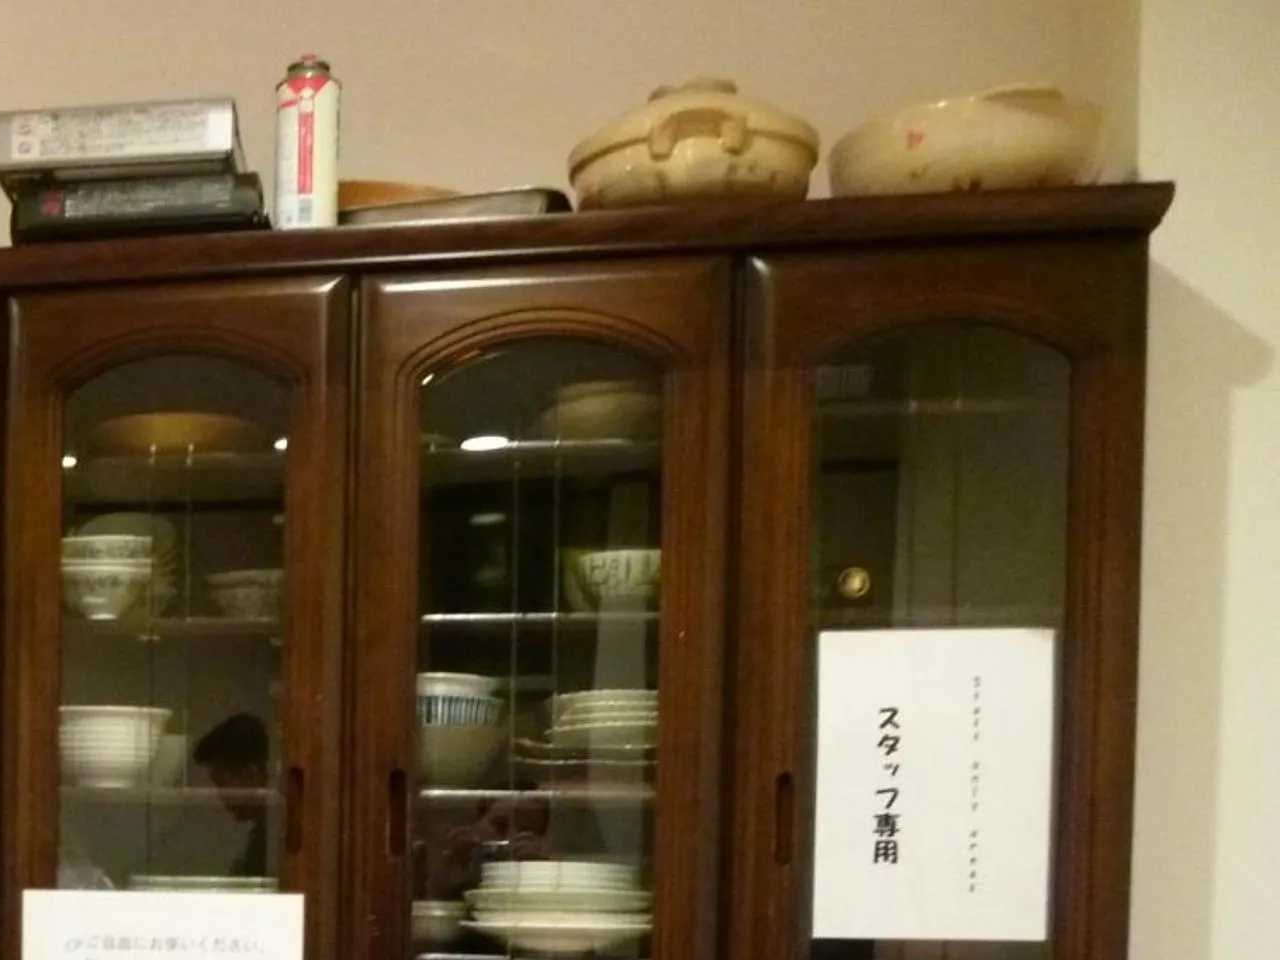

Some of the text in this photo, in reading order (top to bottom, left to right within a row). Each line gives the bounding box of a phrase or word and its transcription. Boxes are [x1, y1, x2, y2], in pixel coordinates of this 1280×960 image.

[873, 706, 902, 865] スタッフ専用
